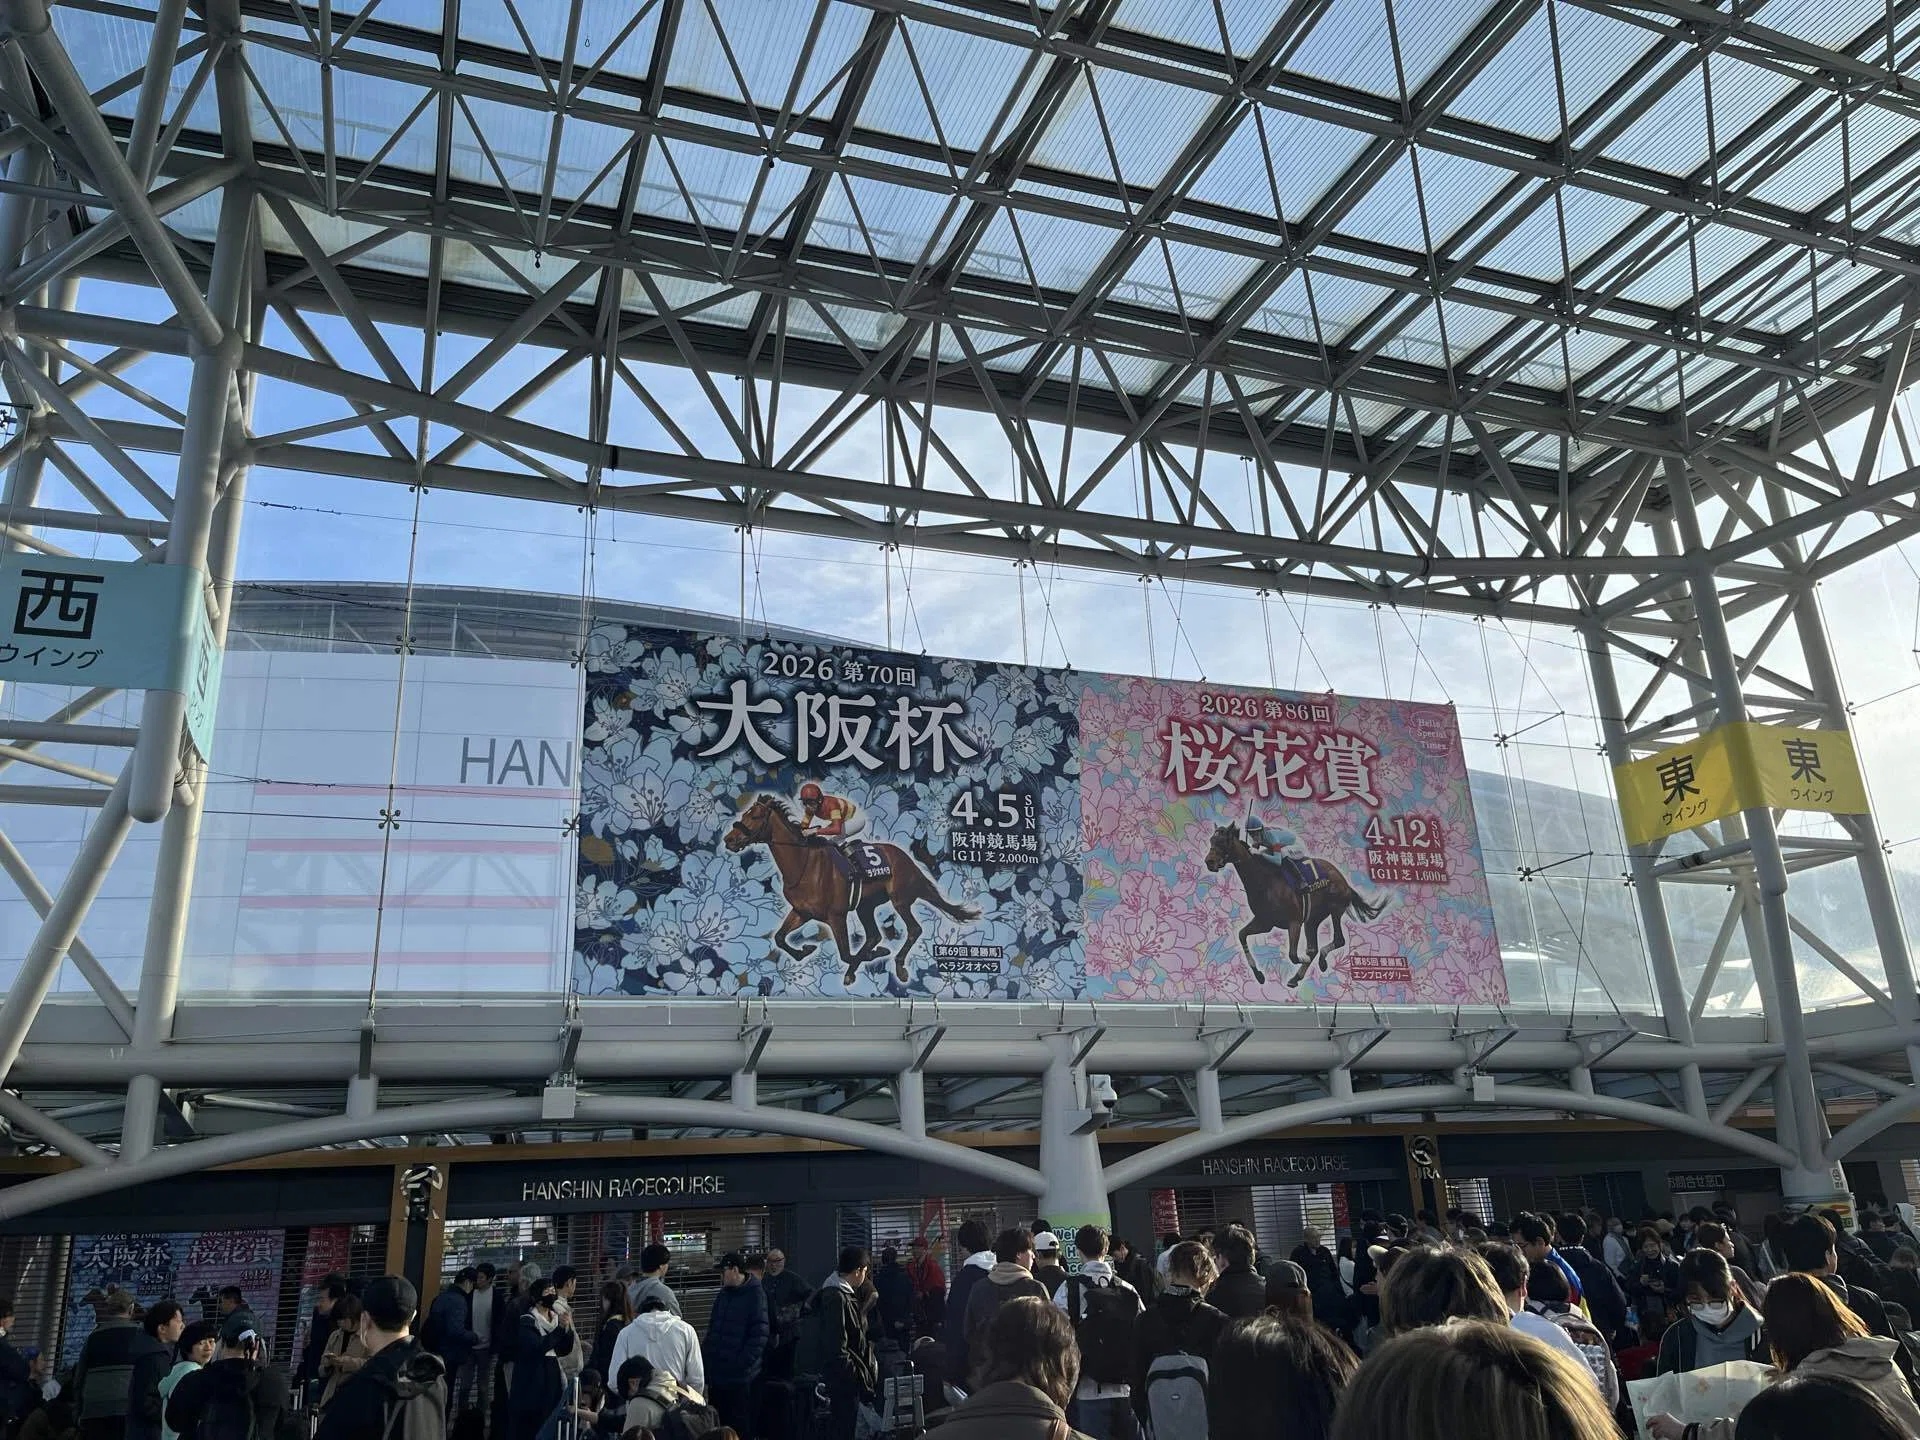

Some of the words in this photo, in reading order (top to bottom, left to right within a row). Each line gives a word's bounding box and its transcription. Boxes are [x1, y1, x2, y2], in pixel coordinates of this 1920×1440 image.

[14, 569, 104, 640] 西
[0, 643, 104, 670] ウイング
[763, 651, 834, 681] 2026
[842, 660, 916, 688] 第70回
[1201, 694, 1258, 717] 2026
[1264, 700, 1330, 722] 第86回
[696, 679, 979, 773] 大阪杯
[1162, 721, 1379, 806] 桜花賞
[1782, 738, 1827, 783] 東
[1656, 755, 1700, 805] 東
[951, 791, 1020, 828] 4.5
[1790, 788, 1834, 803] ウイング
[1024, 795, 1036, 830] SUN
[1663, 799, 1708, 826] ウイング
[952, 832, 1038, 851] 阪神競馬場
[1365, 816, 1431, 848] 4.12
[1431, 821, 1441, 849] SUN
[863, 846, 882, 866] 5
[985, 851, 997, 862] 芝
[999, 853, 1039, 864] 2,000m
[1369, 850, 1444, 868] 阪神競馬場
[1202, 1157, 1260, 1175] HANSHIN
[1264, 1154, 1350, 1173] RACECOURSE
[1415, 1166, 1440, 1180] JRA
[522, 1180, 603, 1200] HANSHIN
[608, 1176, 726, 1198] RACECOURSE
[83, 1242, 172, 1269] 大阪杯
[189, 1238, 275, 1266] 桜花賞
